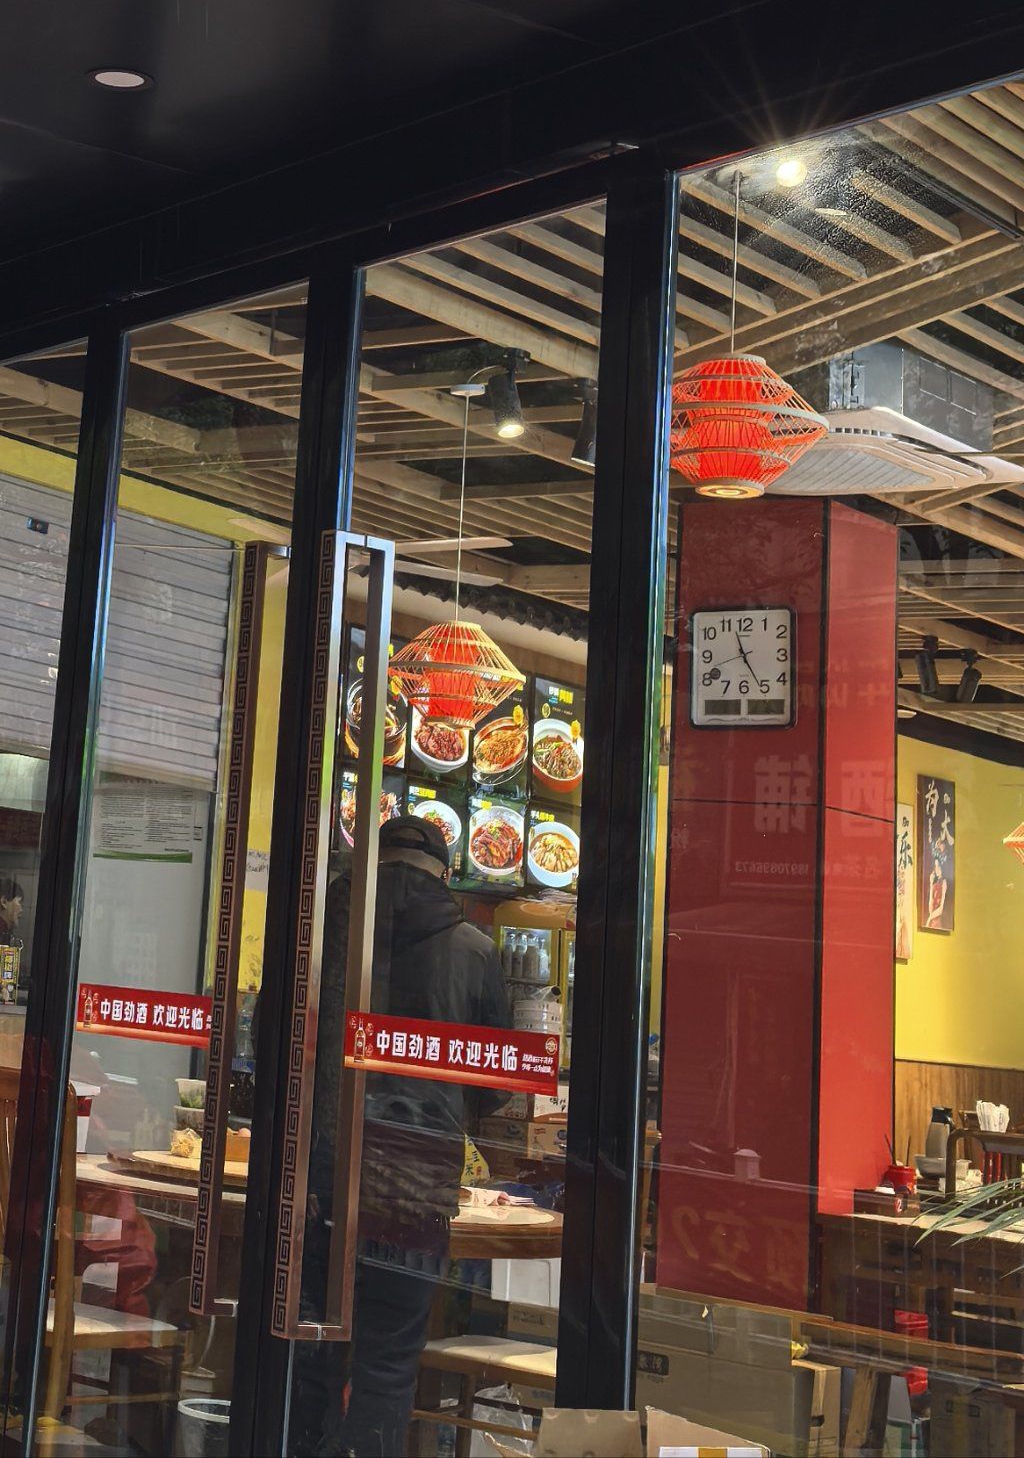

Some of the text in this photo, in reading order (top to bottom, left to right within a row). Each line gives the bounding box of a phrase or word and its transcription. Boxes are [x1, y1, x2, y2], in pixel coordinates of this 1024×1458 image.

[720, 618, 732, 633] 11
[736, 617, 753, 633] 12
[761, 617, 768, 632] 1
[776, 624, 788, 639] 2
[702, 626, 717, 641] 10
[701, 649, 713, 664] 9
[776, 647, 788, 663] 3
[701, 672, 713, 687] 8
[759, 679, 770, 694] 5
[776, 671, 788, 687] 4
[720, 679, 731, 695] 7
[738, 679, 750, 695] 6
[100, 998, 149, 1024] 中国劲酒
[152, 1004, 205, 1031] 欢迎光临
[376, 1029, 441, 1062] 中国劲酒
[448, 1038, 519, 1072] 欢迎光临
